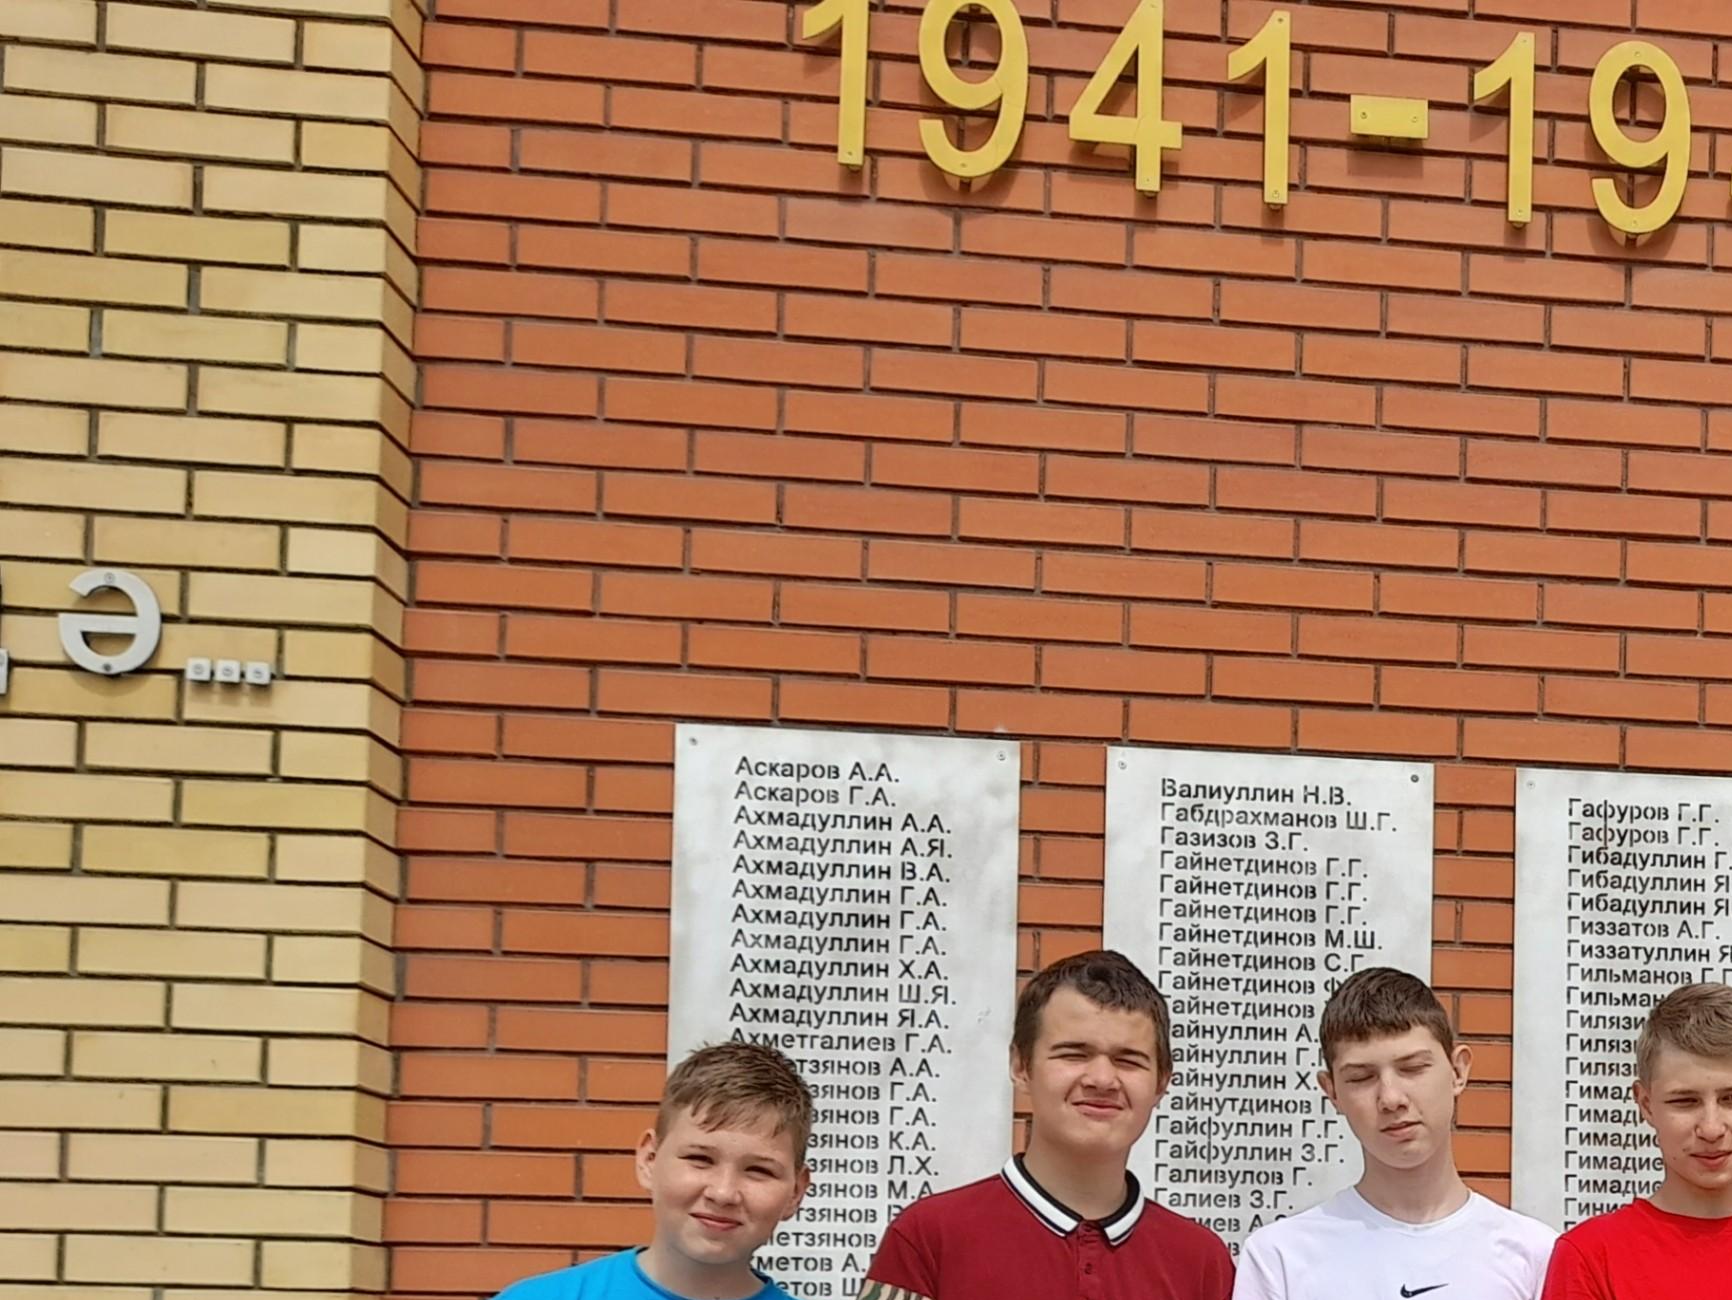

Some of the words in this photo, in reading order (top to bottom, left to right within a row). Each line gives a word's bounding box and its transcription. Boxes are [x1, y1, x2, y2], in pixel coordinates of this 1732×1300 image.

[735, 755, 841, 782] Аскаров
[848, 760, 900, 782] А.А.
[734, 780, 840, 807] Аскаров
[849, 785, 896, 807] Г.А.
[1161, 778, 1294, 804] Валиуллин
[1303, 785, 1351, 806] Н.В.
[734, 804, 892, 832] Ахмадуллин
[900, 812, 951, 834] А.А.
[1161, 802, 1337, 829] Габдрахманов
[1346, 811, 1397, 832] Ш.Г.
[1567, 798, 1670, 823] Гафуров
[1677, 803, 1720, 823] Г.Г.
[733, 829, 892, 857] Ахмадуллин
[900, 836, 952, 858] А.Я.
[1160, 826, 1257, 849] Газизов
[1264, 831, 1308, 851] З.Г.
[1568, 821, 1669, 847] Гафуров
[1677, 827, 1719, 846] Г.Г.
[732, 854, 891, 881] Ахмадуллин
[900, 861, 950, 882] В.А.
[1159, 850, 1317, 876] Гайнетдинов
[1325, 857, 1369, 878] Г.Г.
[1567, 845, 1707, 871] Гибадуллин
[732, 878, 891, 906] Ахмадуллин
[900, 885, 947, 907] Г.А.
[1567, 868, 1707, 894] Гибадуллин
[1158, 898, 1317, 924] Гайнетдинов
[1324, 905, 1368, 926] Г.Г.
[1567, 892, 1706, 917] Гибадуллин
[1159, 923, 1316, 948] Гайнетдинов
[1324, 929, 1382, 950] М.Ш.
[1567, 916, 1670, 937] Гиззатов
[1676, 920, 1720, 939] А.Г.
[731, 928, 890, 955] Ахмадуллин
[899, 934, 946, 955] Г.А.
[1567, 939, 1710, 964] Гиззатуллин
[730, 953, 889, 980] Ахмадуллин
[898, 959, 948, 980] Х.А.
[1566, 963, 1693, 985] Гильманов
[729, 977, 889, 1004] Ахмадуллин
[898, 983, 956, 1005] Ш.Я.
[729, 1002, 888, 1029] Ахмадуллин
[897, 1008, 949, 1029] Я.А.
[1154, 1116, 1293, 1141] Гайфуллин
[1301, 1120, 1345, 1140] Г.Г.
[1155, 1140, 1292, 1165] Гайфуллин
[1300, 1144, 1344, 1164] З.Г.
[1153, 1164, 1284, 1189] Галивулов
[1292, 1168, 1313, 1187] Г.
[1153, 1188, 1241, 1209] Галиев
[1248, 1191, 1294, 1210] З.Г.
